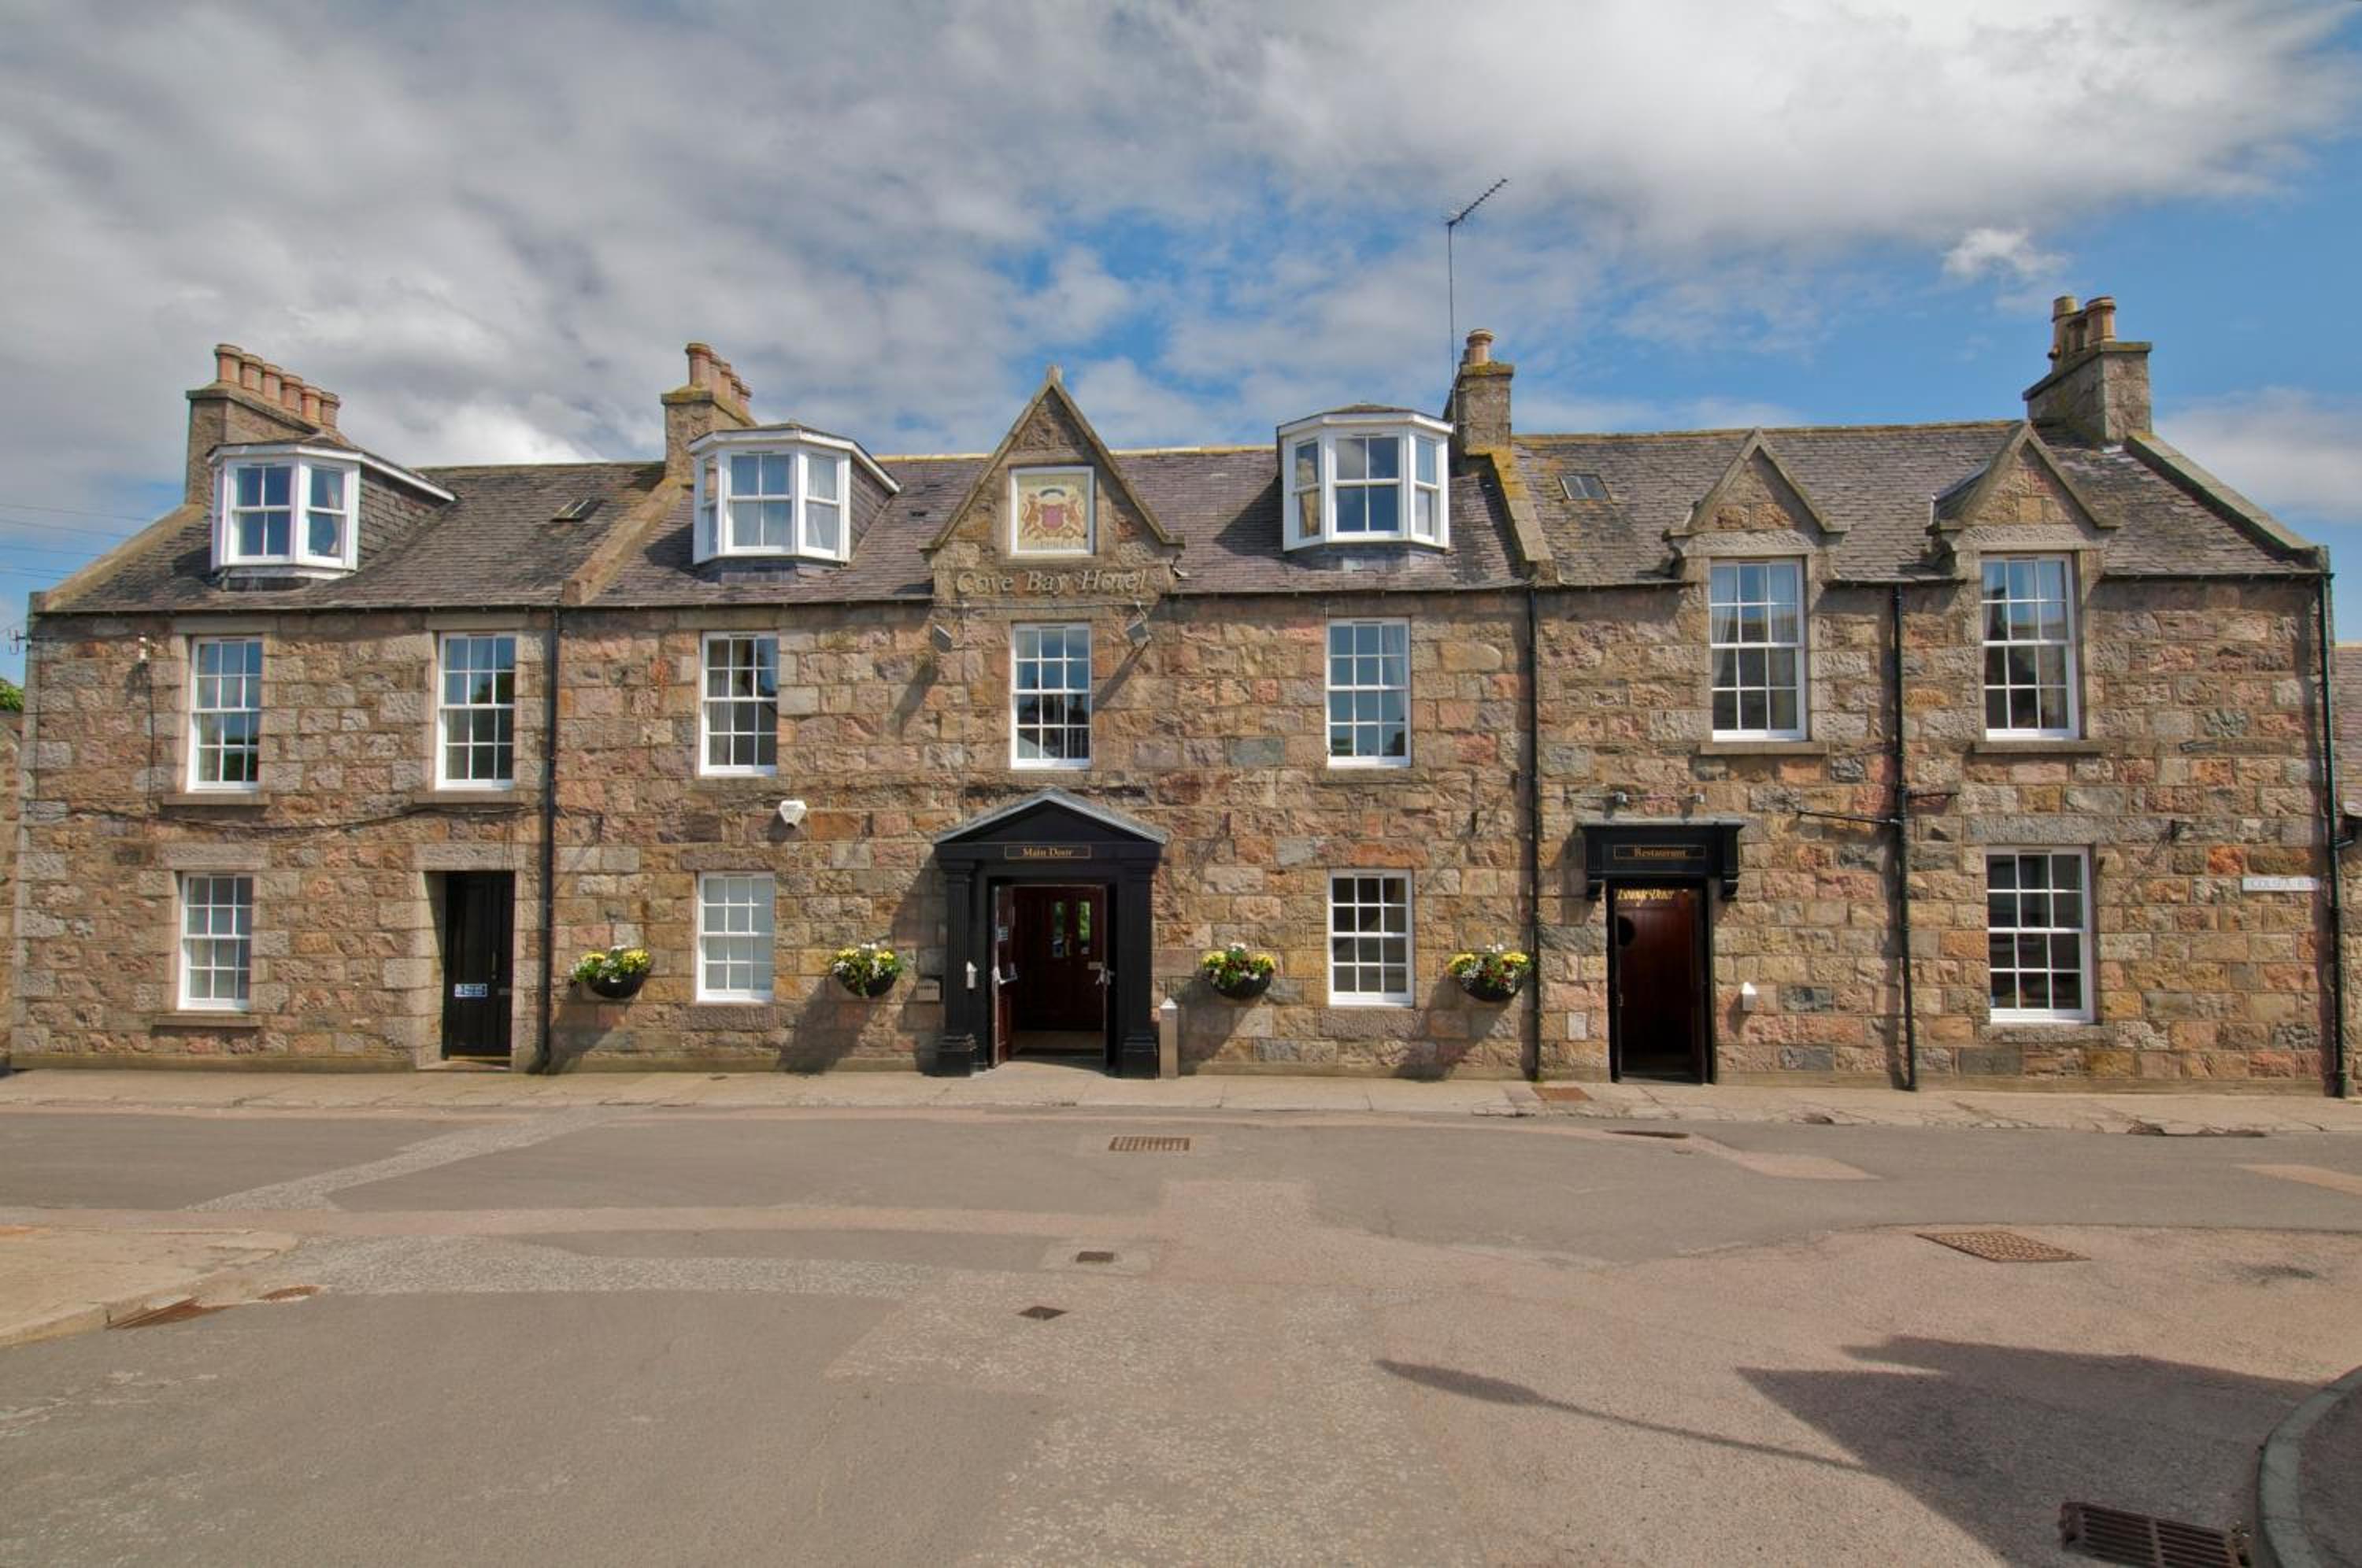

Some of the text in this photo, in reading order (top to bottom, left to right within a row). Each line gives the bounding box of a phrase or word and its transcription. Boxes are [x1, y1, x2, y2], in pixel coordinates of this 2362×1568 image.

[956, 568, 1147, 594] Cove Bay Hotel
[1023, 847, 1073, 857] Main Door
[1634, 847, 1686, 857] Restaurant
